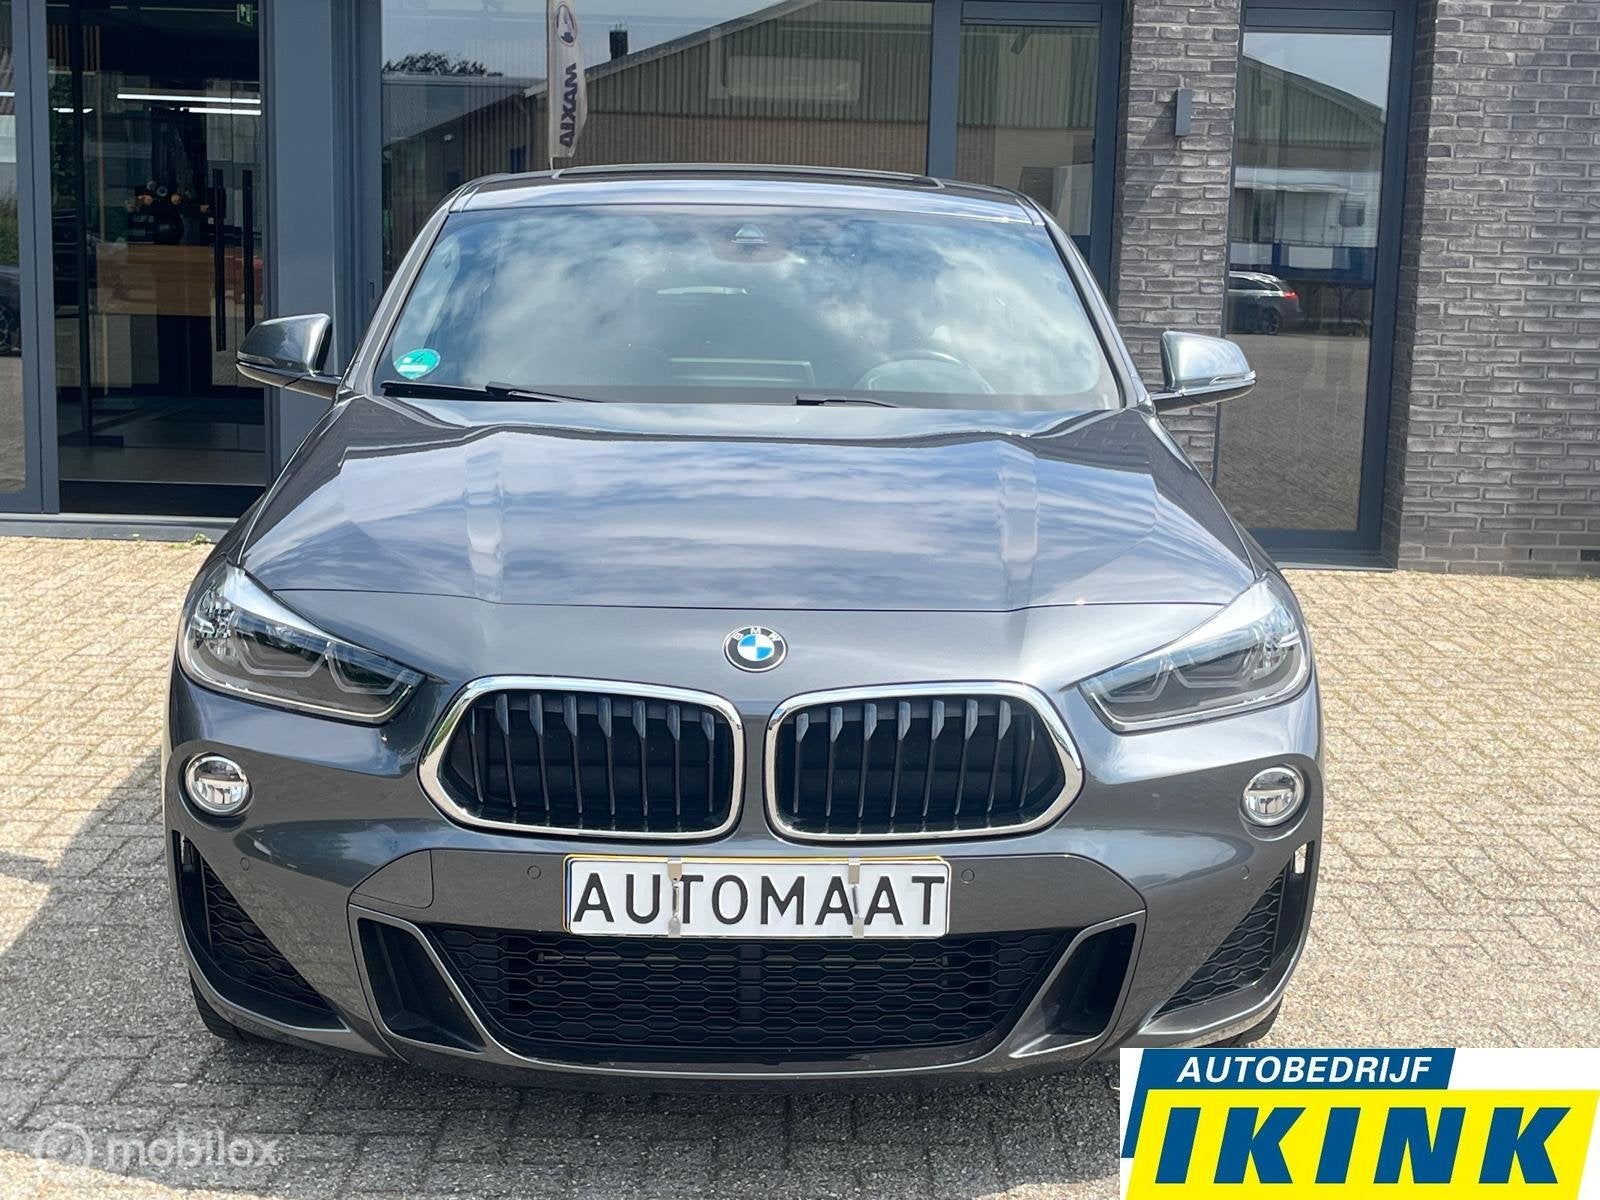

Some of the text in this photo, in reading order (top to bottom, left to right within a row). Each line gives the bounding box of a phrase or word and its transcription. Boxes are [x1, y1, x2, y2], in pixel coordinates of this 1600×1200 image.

[559, 63, 578, 148] AIXAM
[732, 627, 782, 641] BMW
[572, 873, 945, 926] AUTOMAAT
